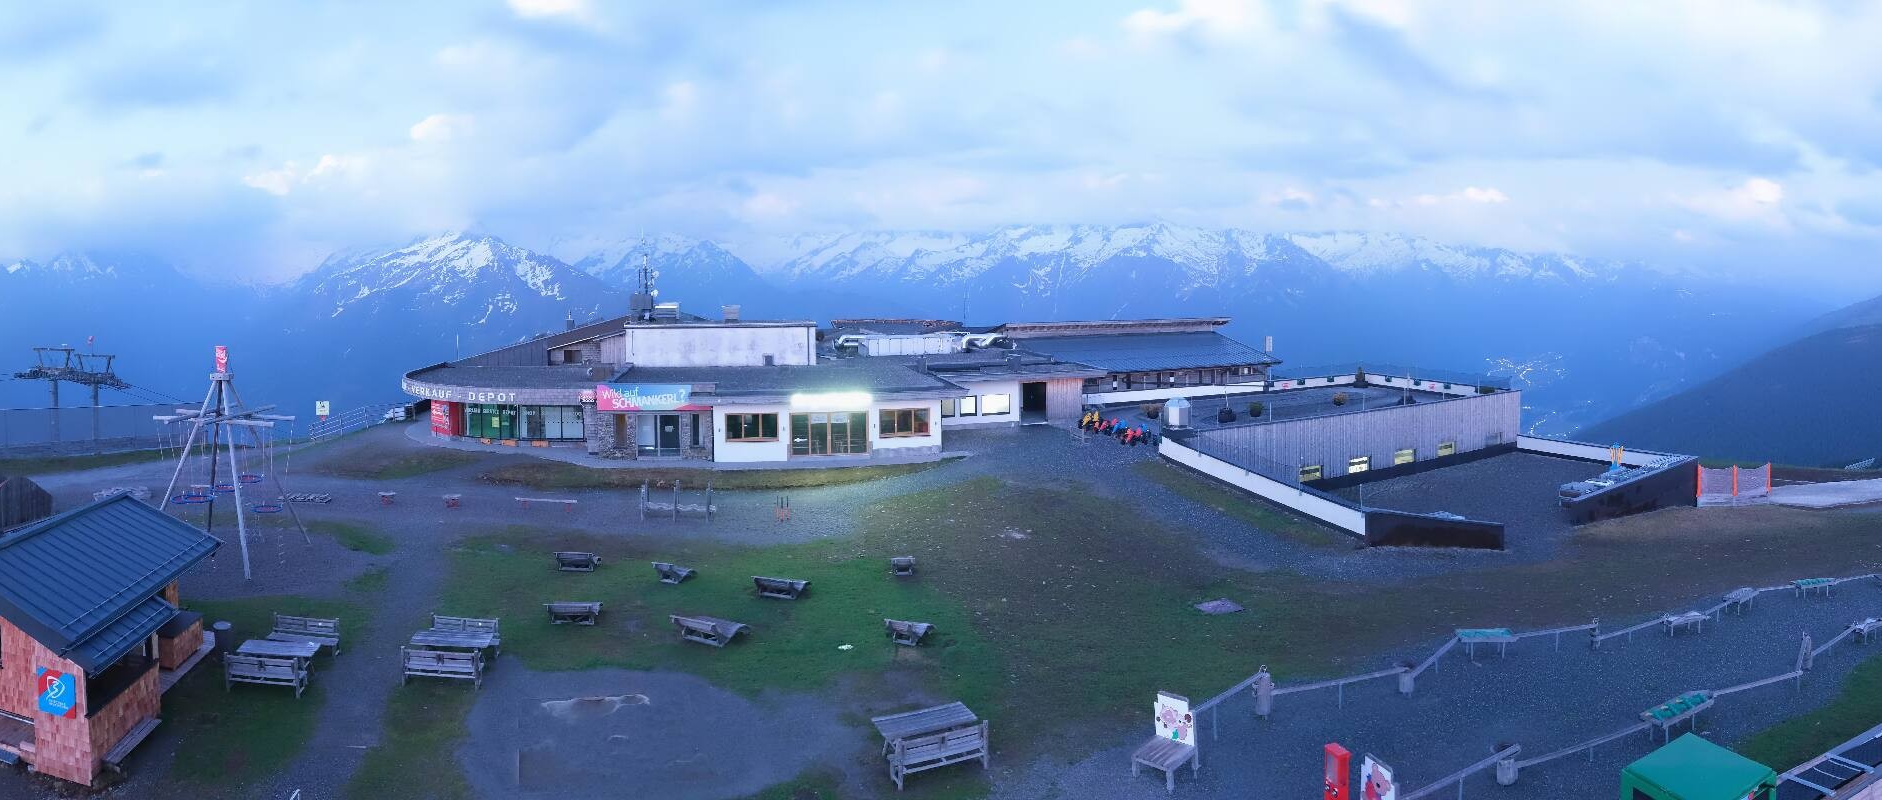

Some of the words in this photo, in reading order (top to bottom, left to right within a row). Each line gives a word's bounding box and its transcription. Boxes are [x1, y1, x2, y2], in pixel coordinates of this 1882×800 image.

[411, 385, 452, 399] VERKAUF
[468, 391, 516, 402] DEPOT
[602, 389, 622, 399] Wild
[623, 386, 639, 398] auf
[612, 388, 686, 408] SCHMANKERL?
